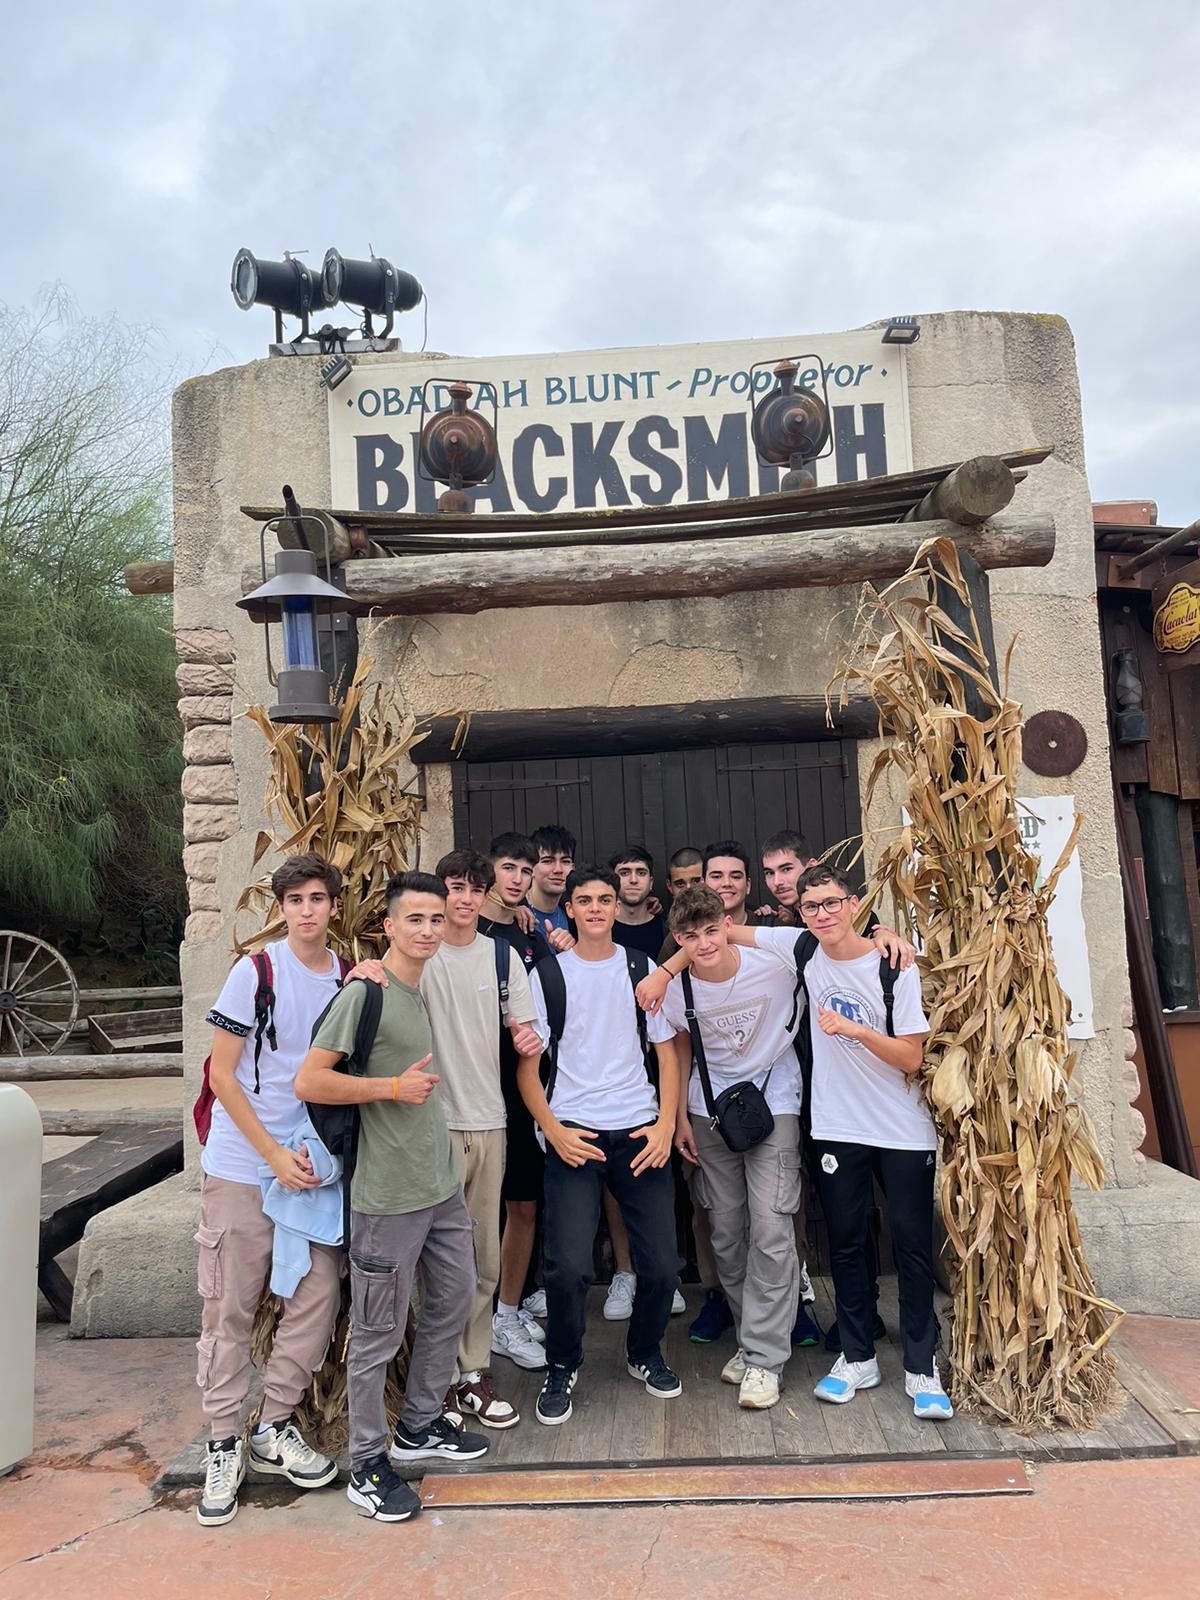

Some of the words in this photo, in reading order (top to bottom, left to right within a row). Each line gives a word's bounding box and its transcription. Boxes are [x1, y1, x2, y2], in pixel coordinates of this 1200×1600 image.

[357, 379, 529, 417] OBADAH
[545, 371, 661, 406] BLUNT
[687, 362, 874, 401] Propetor
[353, 402, 888, 514] BLACKSMH
[716, 1010, 757, 1029] GUESS
